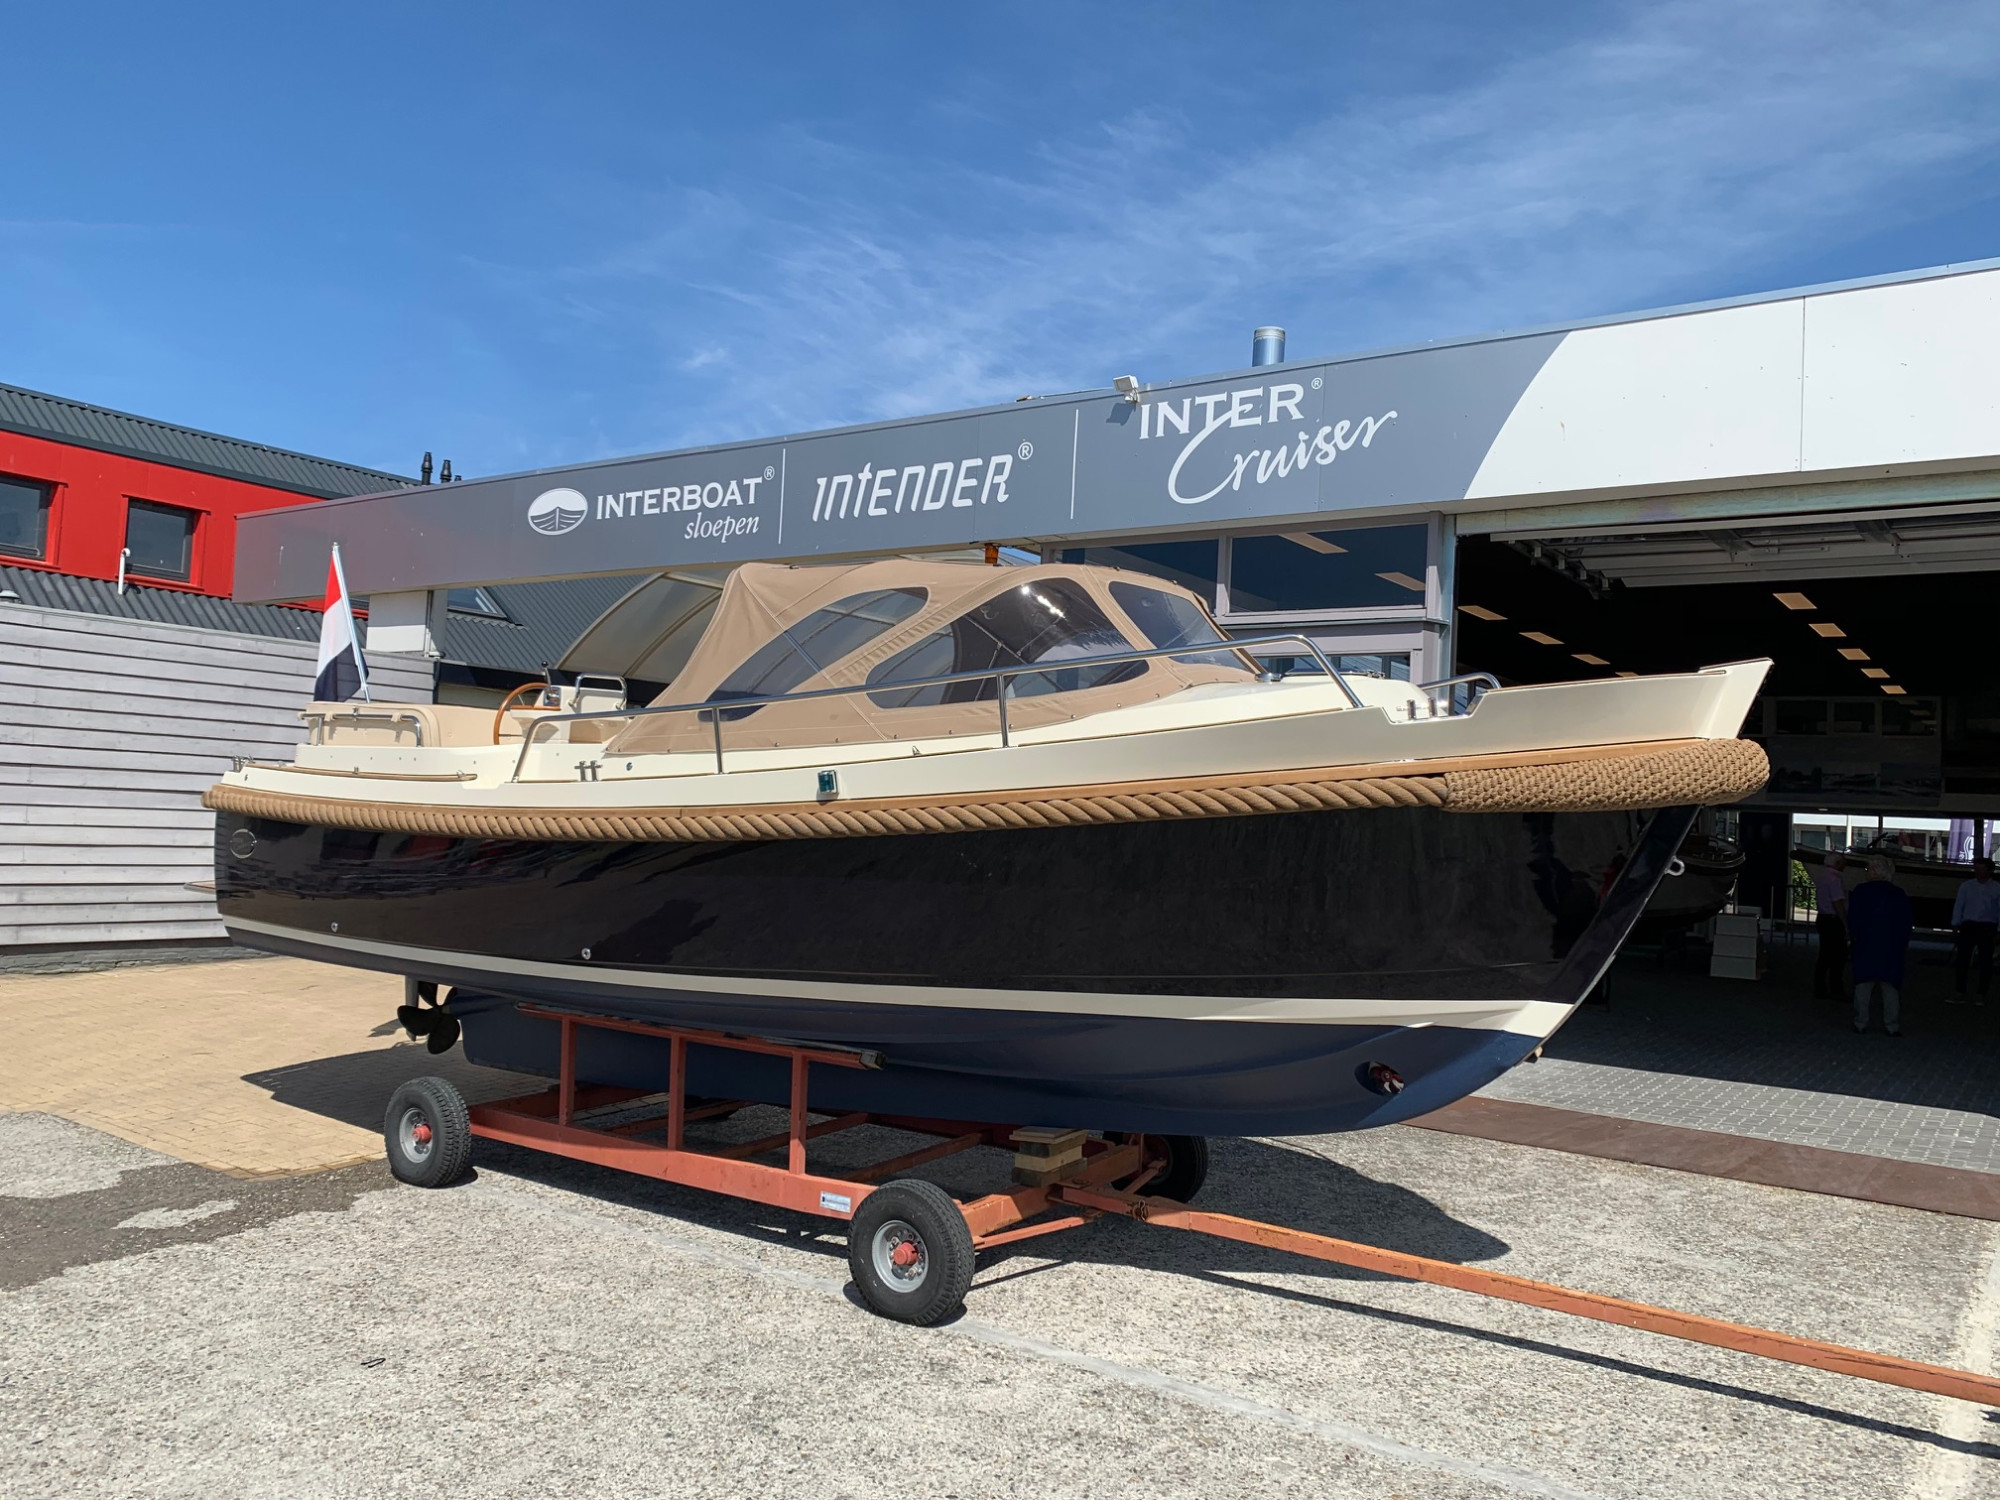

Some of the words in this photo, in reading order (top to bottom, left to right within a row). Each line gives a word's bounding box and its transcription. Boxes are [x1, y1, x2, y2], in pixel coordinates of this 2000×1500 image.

[1139, 383, 1305, 440] INTER
[1168, 403, 1398, 505] Cruiser
[596, 475, 763, 520] INTERBOAT
[684, 511, 761, 544] sloepen
